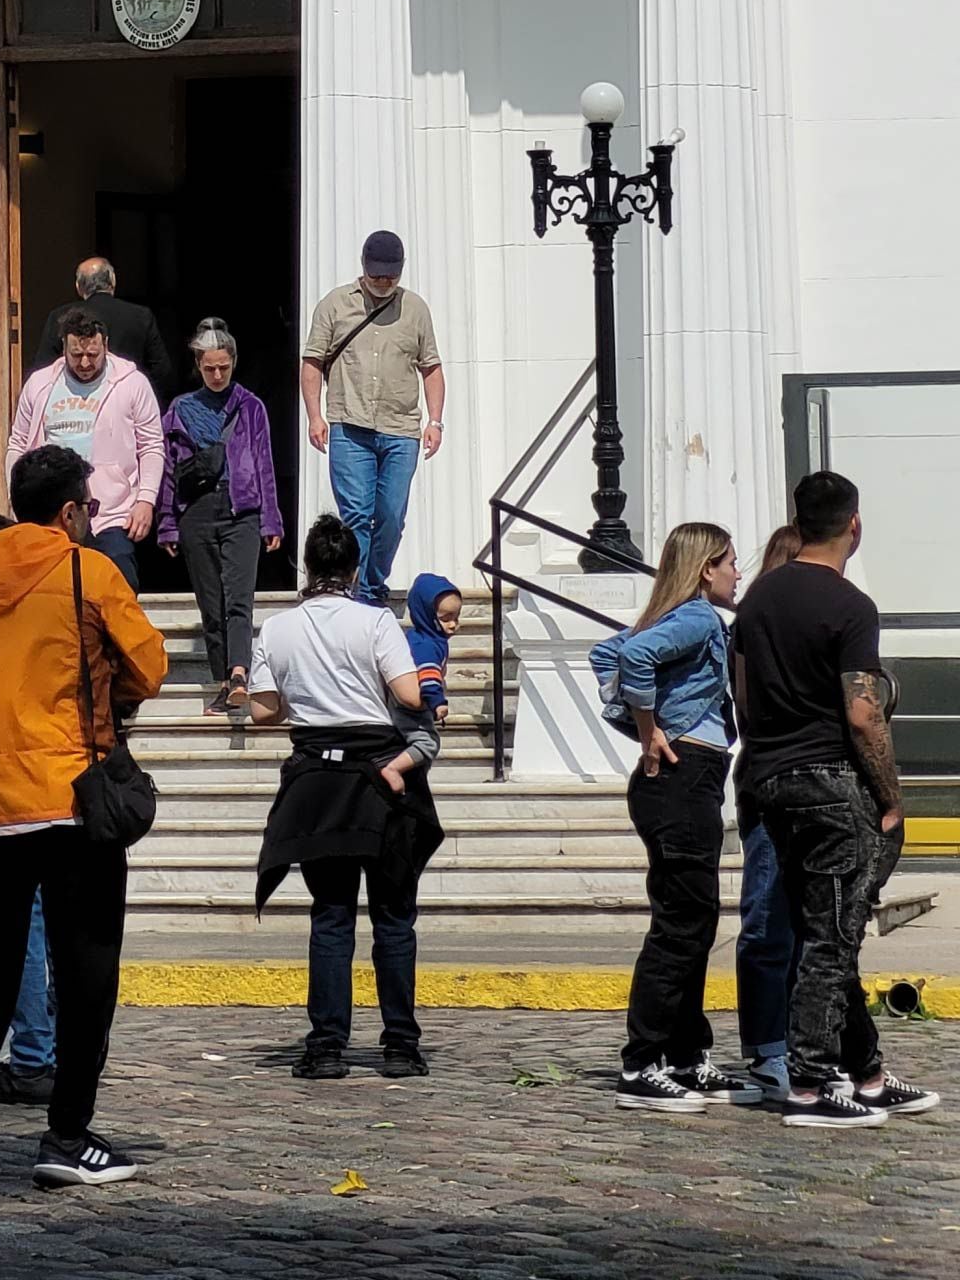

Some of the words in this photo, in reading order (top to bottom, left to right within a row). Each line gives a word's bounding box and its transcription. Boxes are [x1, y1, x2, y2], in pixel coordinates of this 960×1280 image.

[151, 17, 186, 40] CREMATORIO
[129, 34, 137, 42] DE
[138, 39, 160, 47] BUENOS
[161, 35, 178, 46] AIRES
